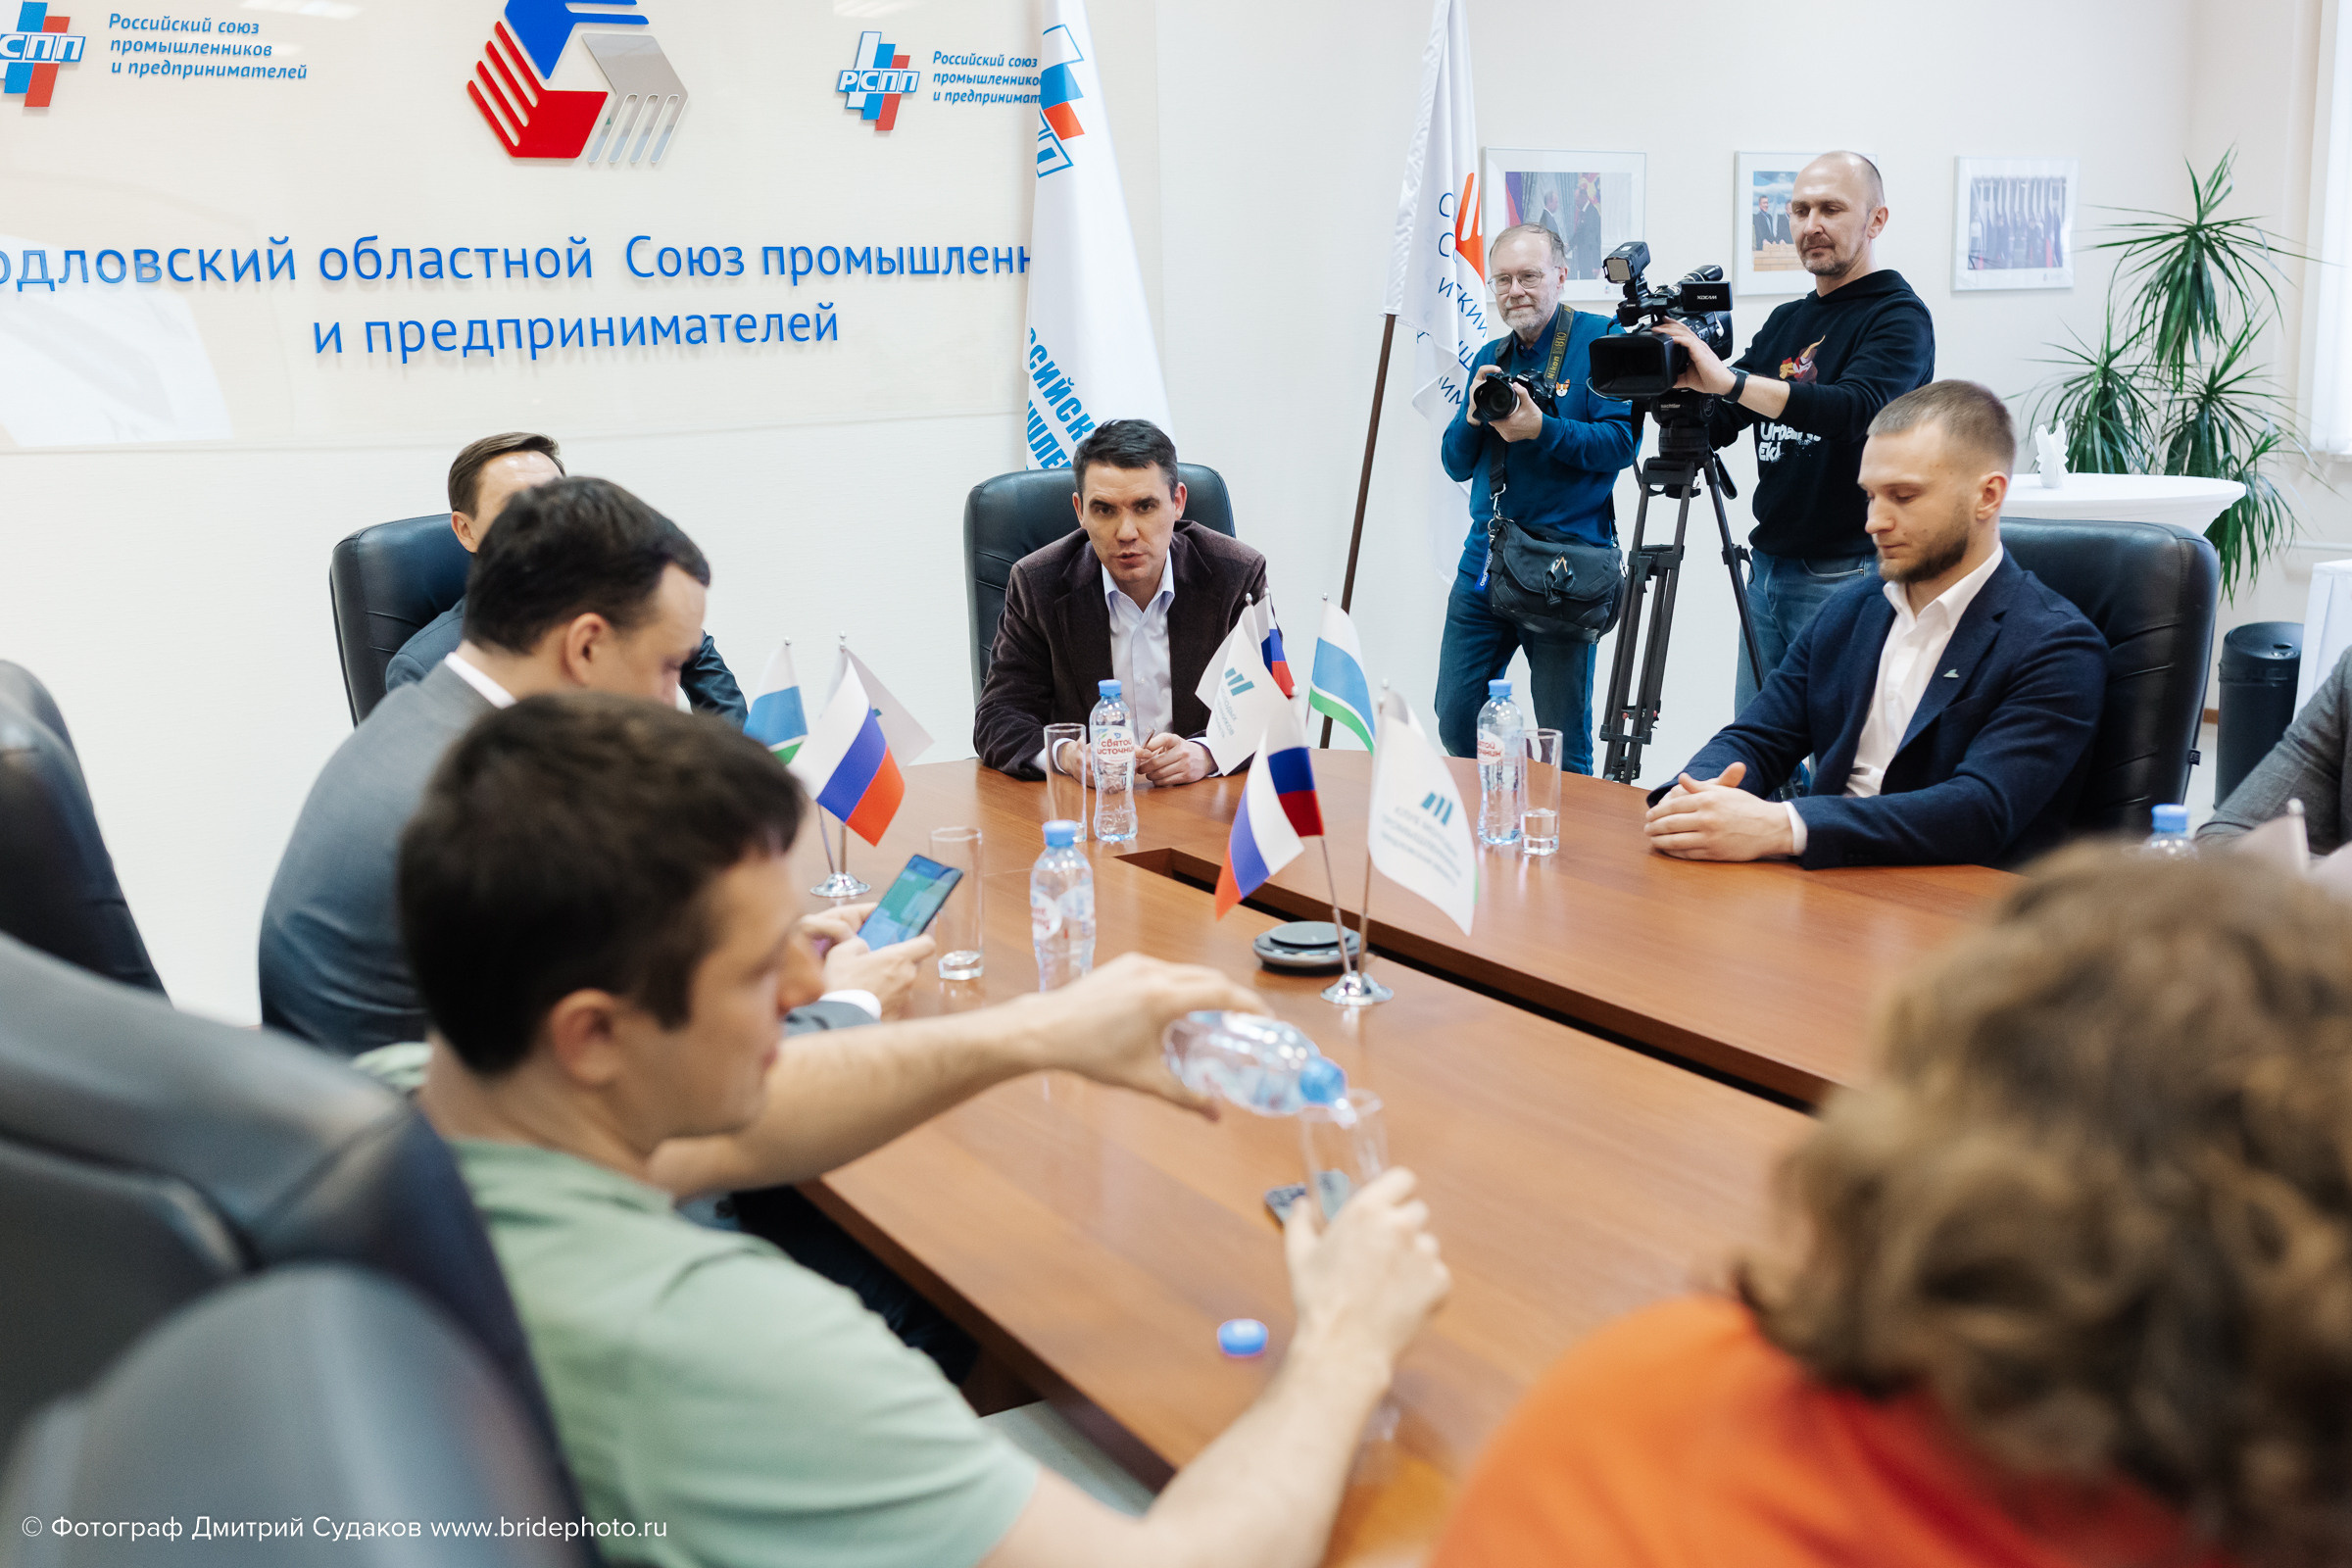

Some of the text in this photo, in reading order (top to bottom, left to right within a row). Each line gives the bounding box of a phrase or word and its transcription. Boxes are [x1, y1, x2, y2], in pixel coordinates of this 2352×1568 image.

[109, 13, 260, 35] Российский союз
[0, 34, 85, 61] СПП
[110, 38, 273, 57] промышленников
[111, 59, 308, 79] и предпринимателей
[933, 50, 1039, 68] Российский союз
[838, 71, 919, 92] РСПП
[933, 72, 1041, 89] промышленнико
[933, 90, 1041, 107] и предпринимат
[319, 235, 593, 281] областной
[626, 235, 745, 278] Союз
[762, 246, 1031, 287] промышленн
[313, 302, 839, 365] и предпринимателей
[1546, 356, 1560, 379] Nikon
